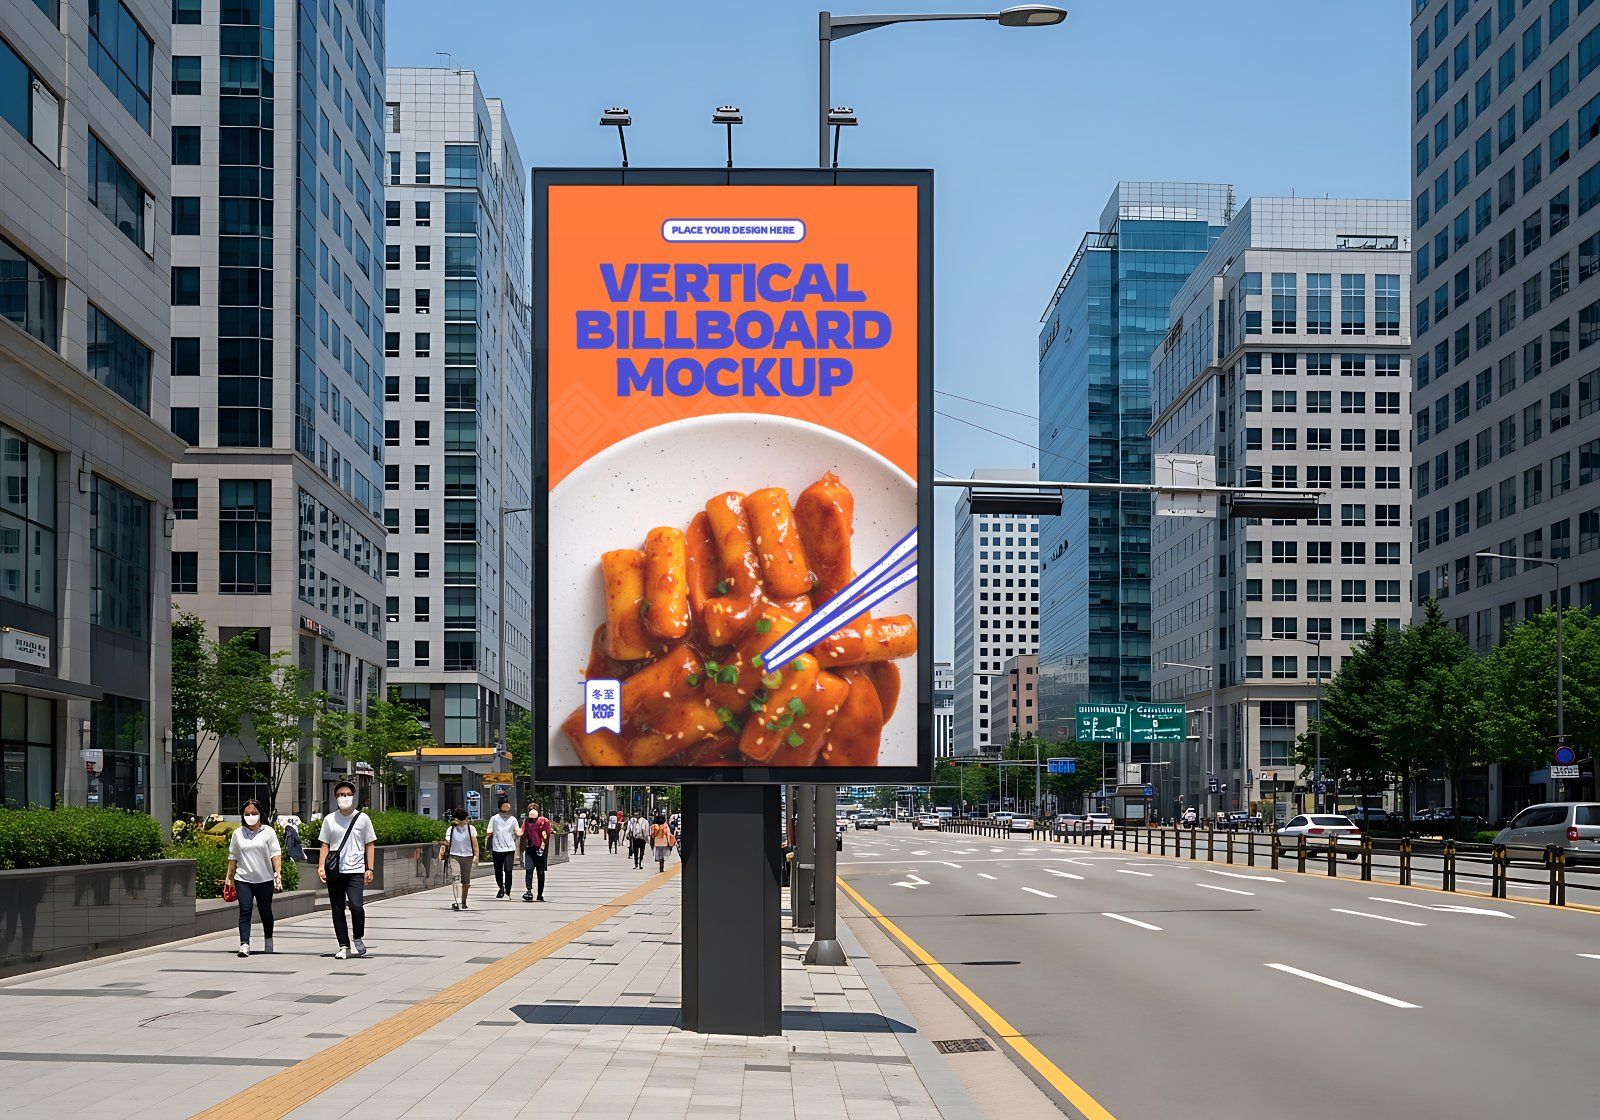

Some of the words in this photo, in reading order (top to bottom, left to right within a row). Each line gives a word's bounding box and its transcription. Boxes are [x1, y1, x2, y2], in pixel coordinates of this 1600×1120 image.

[672, 226, 703, 234] PLACE
[705, 226, 730, 234] YOUR
[732, 226, 768, 234] DESIGN
[770, 226, 795, 234] HERE
[599, 263, 867, 303] VERTICAL
[576, 310, 892, 350] BILLBOARD
[616, 357, 854, 397] MOCKUP
[592, 689, 614, 699] 冬至
[593, 711, 614, 719] KUP
